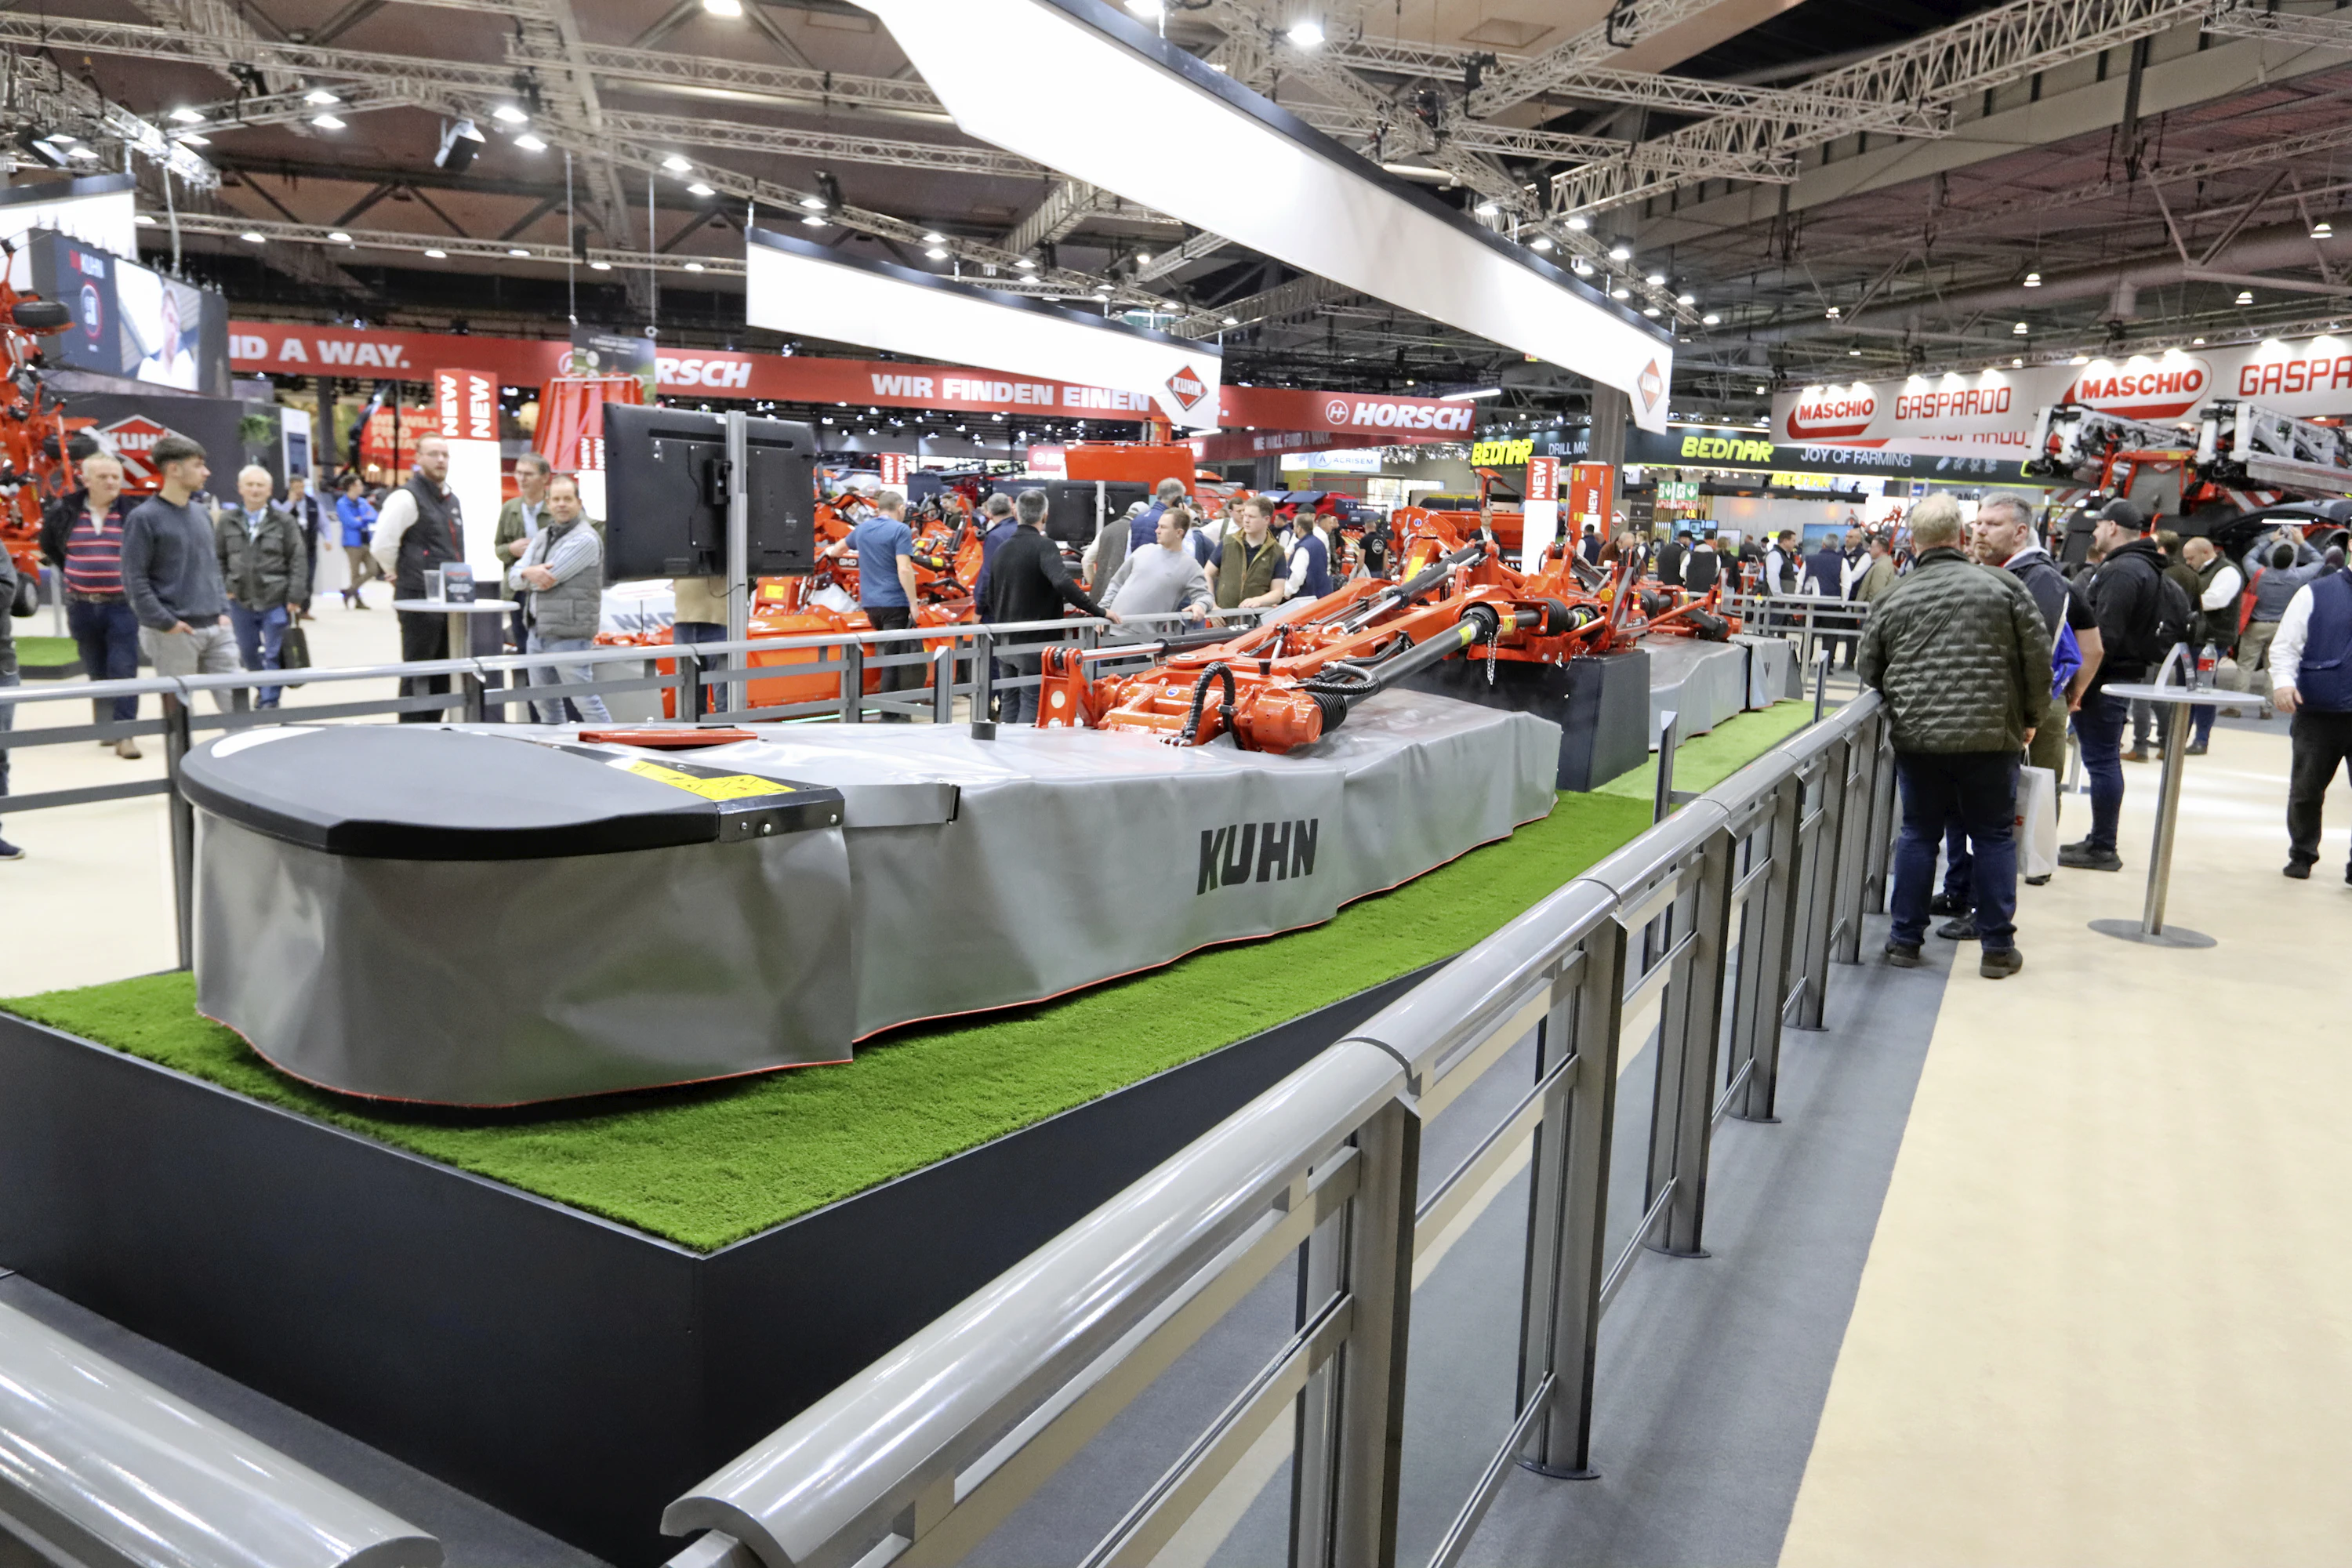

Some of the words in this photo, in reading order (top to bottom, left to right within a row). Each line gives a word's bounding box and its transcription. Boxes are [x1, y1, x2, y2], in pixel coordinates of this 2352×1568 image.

[278, 338, 309, 362] A
[317, 339, 411, 369] WAY.
[871, 374, 934, 397] WIR
[943, 378, 1054, 405] FINDEN
[1063, 386, 1149, 412] EINEN
[1173, 376, 1203, 397] KUHN
[2081, 369, 2204, 399] MASCHIO
[440, 375, 459, 437] NEW
[469, 375, 491, 438] NEW
[1352, 402, 1473, 430] HORSCH
[1799, 398, 1875, 421] MASCHIO
[1895, 387, 2012, 420] GASPARDO
[581, 437, 590, 469] NEW
[1471, 438, 1534, 466] BEDNAR
[1548, 442, 1572, 456] DRILL
[1681, 436, 1774, 462] BEDNAR
[1800, 448, 1831, 463] JOY
[1832, 449, 1852, 464] OF
[1853, 450, 1911, 468] FARMING
[884, 456, 894, 484] NEW
[1532, 460, 1547, 499] NEW
[1551, 461, 1560, 499] NEW
[1588, 488, 1599, 514] NEW
[1197, 818, 1319, 895] KUHN
